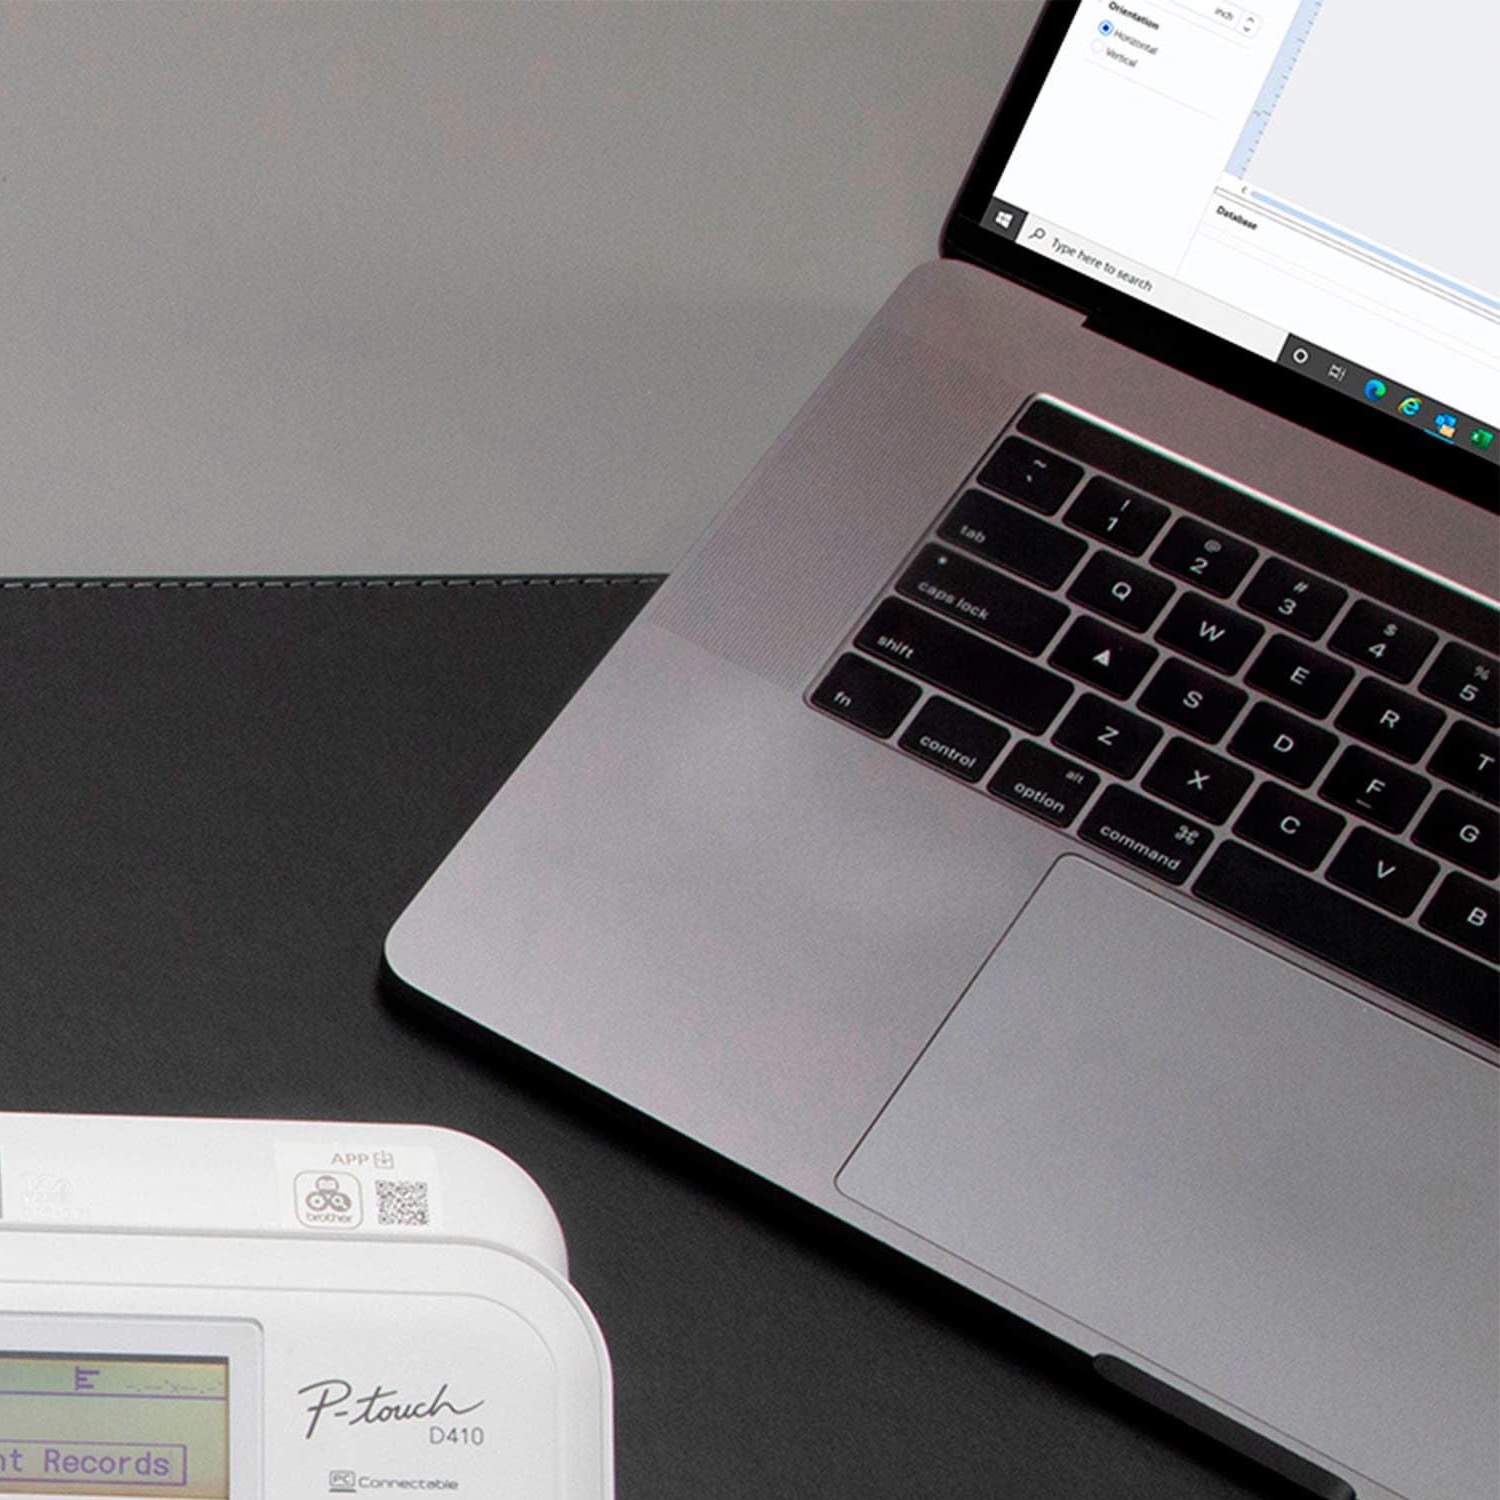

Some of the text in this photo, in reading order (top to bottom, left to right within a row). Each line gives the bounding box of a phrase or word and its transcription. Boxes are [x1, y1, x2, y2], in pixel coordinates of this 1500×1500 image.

[1108, 1, 1159, 30] Orientation
[1114, 29, 1158, 55] Horizontal
[1106, 47, 1138, 68] Vertical
[1216, 205, 1258, 230] Database
[1050, 237, 1153, 292] Type here to search
[960, 524, 986, 544] tab
[1106, 517, 1118, 532] 1
[1189, 557, 1208, 575] 2
[1111, 582, 1132, 600] Q
[917, 581, 989, 621] caps lock
[1278, 598, 1297, 615] 3
[1199, 620, 1226, 642] W
[877, 634, 914, 659] shift
[1368, 643, 1387, 659] 4
[1289, 666, 1311, 685] E
[834, 691, 852, 707] fn
[1183, 691, 1203, 709] S
[1459, 684, 1479, 702] 5
[1379, 709, 1400, 729] R
[1097, 726, 1120, 746] Z
[1273, 735, 1294, 753] D
[919, 733, 977, 769] control
[1477, 753, 1496, 772] T
[1065, 769, 1084, 785] alt
[1186, 769, 1211, 790] X
[1365, 778, 1386, 795] F
[1013, 782, 1065, 814] option
[1279, 816, 1301, 834] C
[1459, 824, 1481, 843] G
[1100, 824, 1181, 871] command
[1377, 860, 1396, 879] V
[1466, 906, 1489, 927] B
[331, 1153, 369, 1165] APP
[306, 1212, 353, 1223] brother
[298, 1379, 485, 1439] P-touch
[429, 1426, 484, 1446] D410
[44, 1448, 170, 1477] Records
[359, 1476, 459, 1490] Connectable
